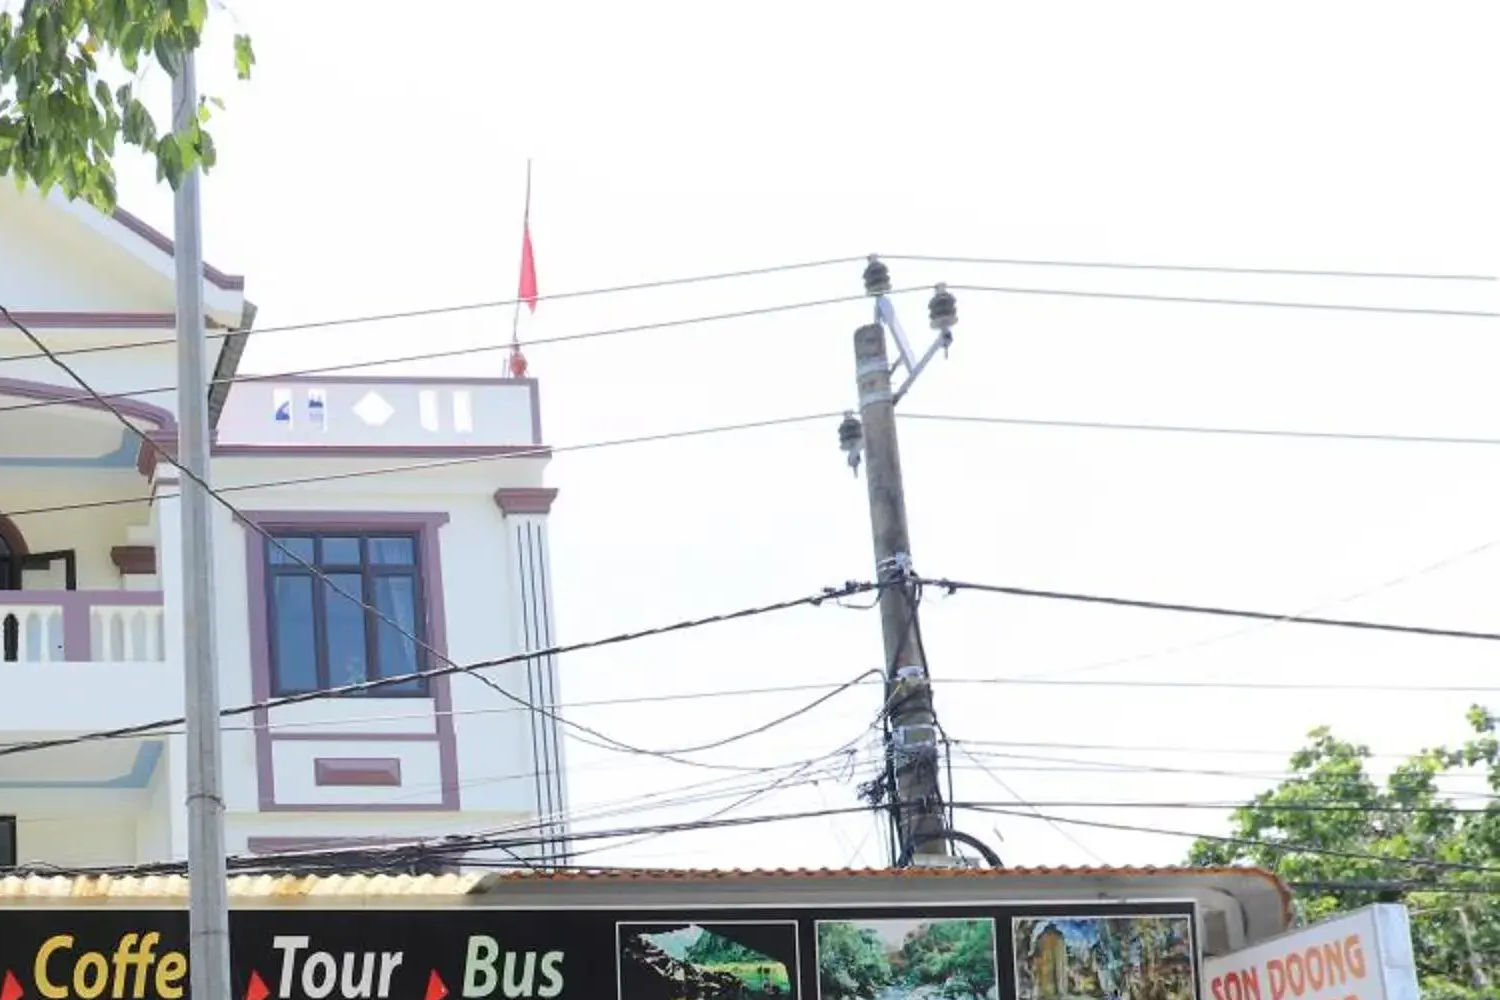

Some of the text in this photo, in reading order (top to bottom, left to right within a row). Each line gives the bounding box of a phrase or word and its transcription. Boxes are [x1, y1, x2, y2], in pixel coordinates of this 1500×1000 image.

[33, 931, 188, 999] Coffe
[273, 935, 404, 999] Tour
[461, 935, 565, 999] Bus
